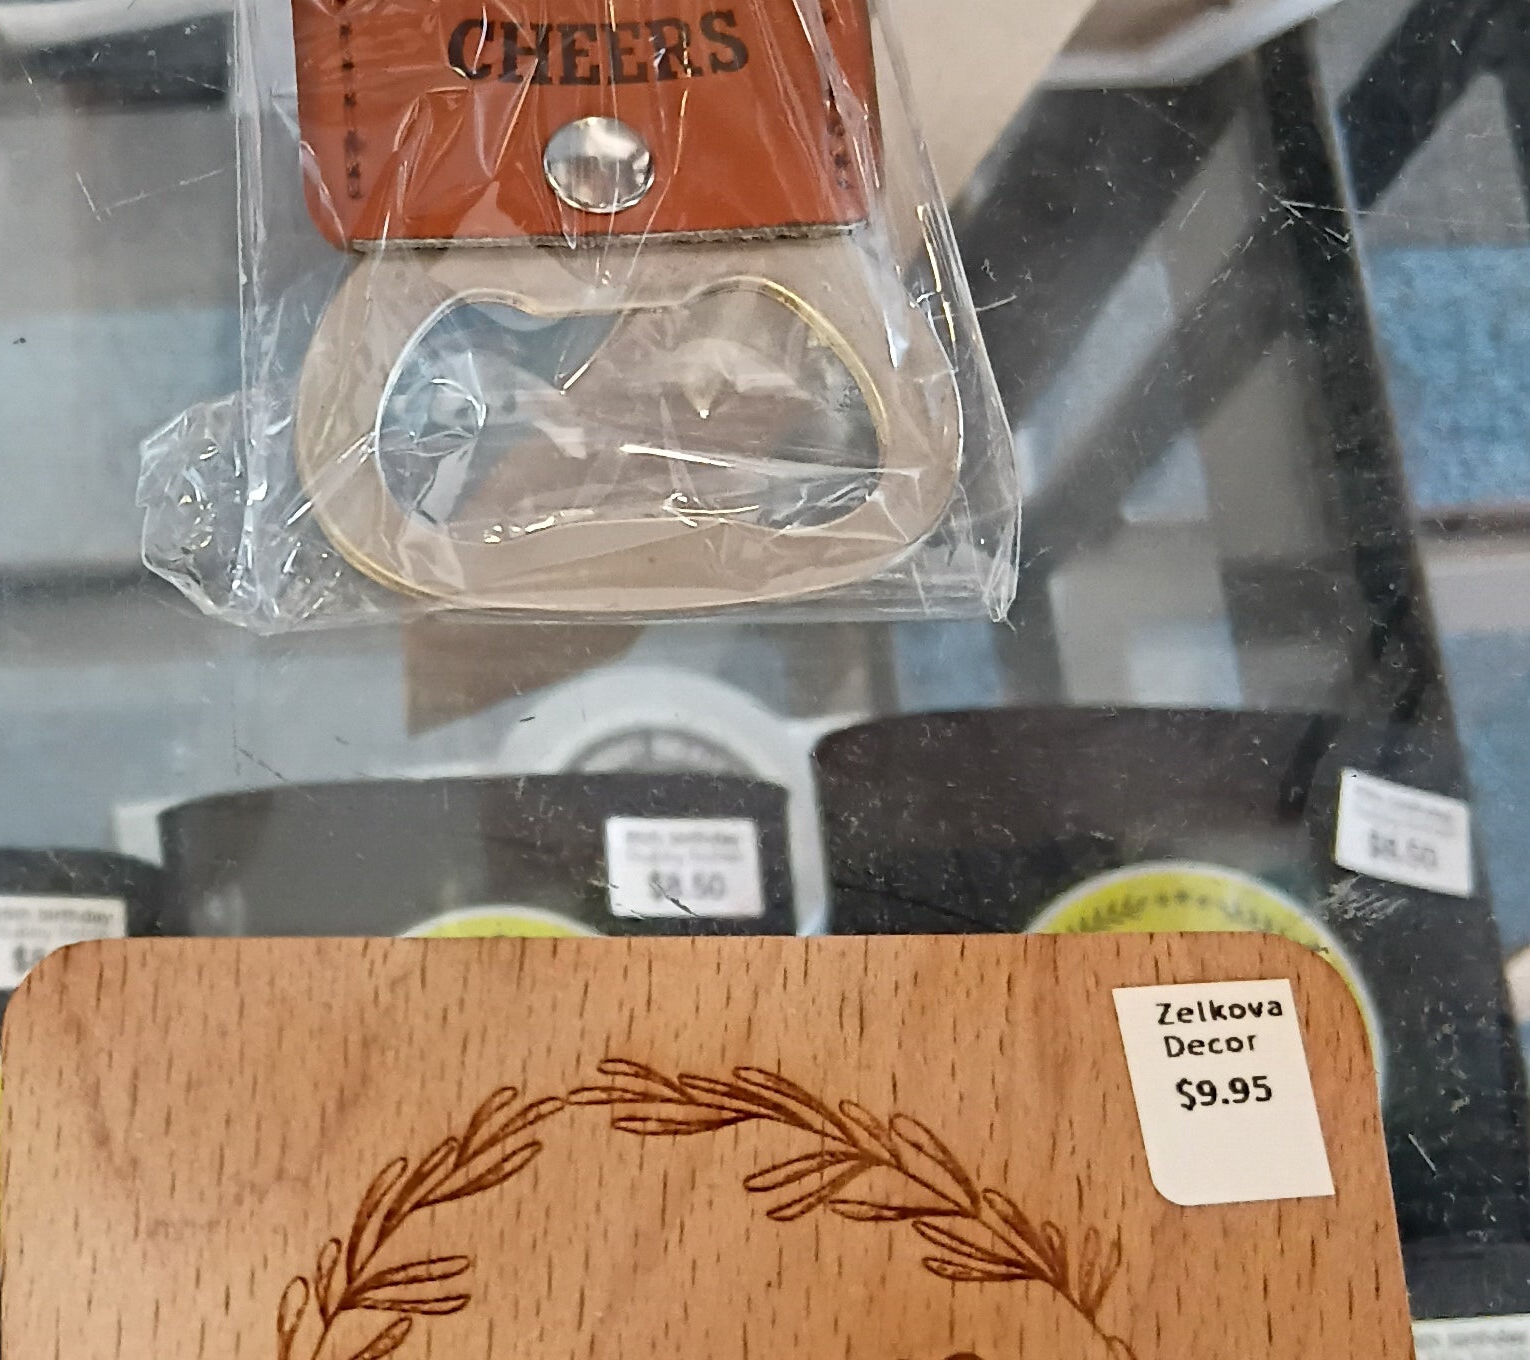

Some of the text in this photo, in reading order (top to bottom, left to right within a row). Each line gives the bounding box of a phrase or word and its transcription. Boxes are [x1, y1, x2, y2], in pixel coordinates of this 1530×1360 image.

[447, 6, 751, 86] CHEERS
[1156, 999, 1283, 1025] Zelkova
[1163, 1034, 1257, 1058] Decor
[1175, 1075, 1272, 1111] $9.95
